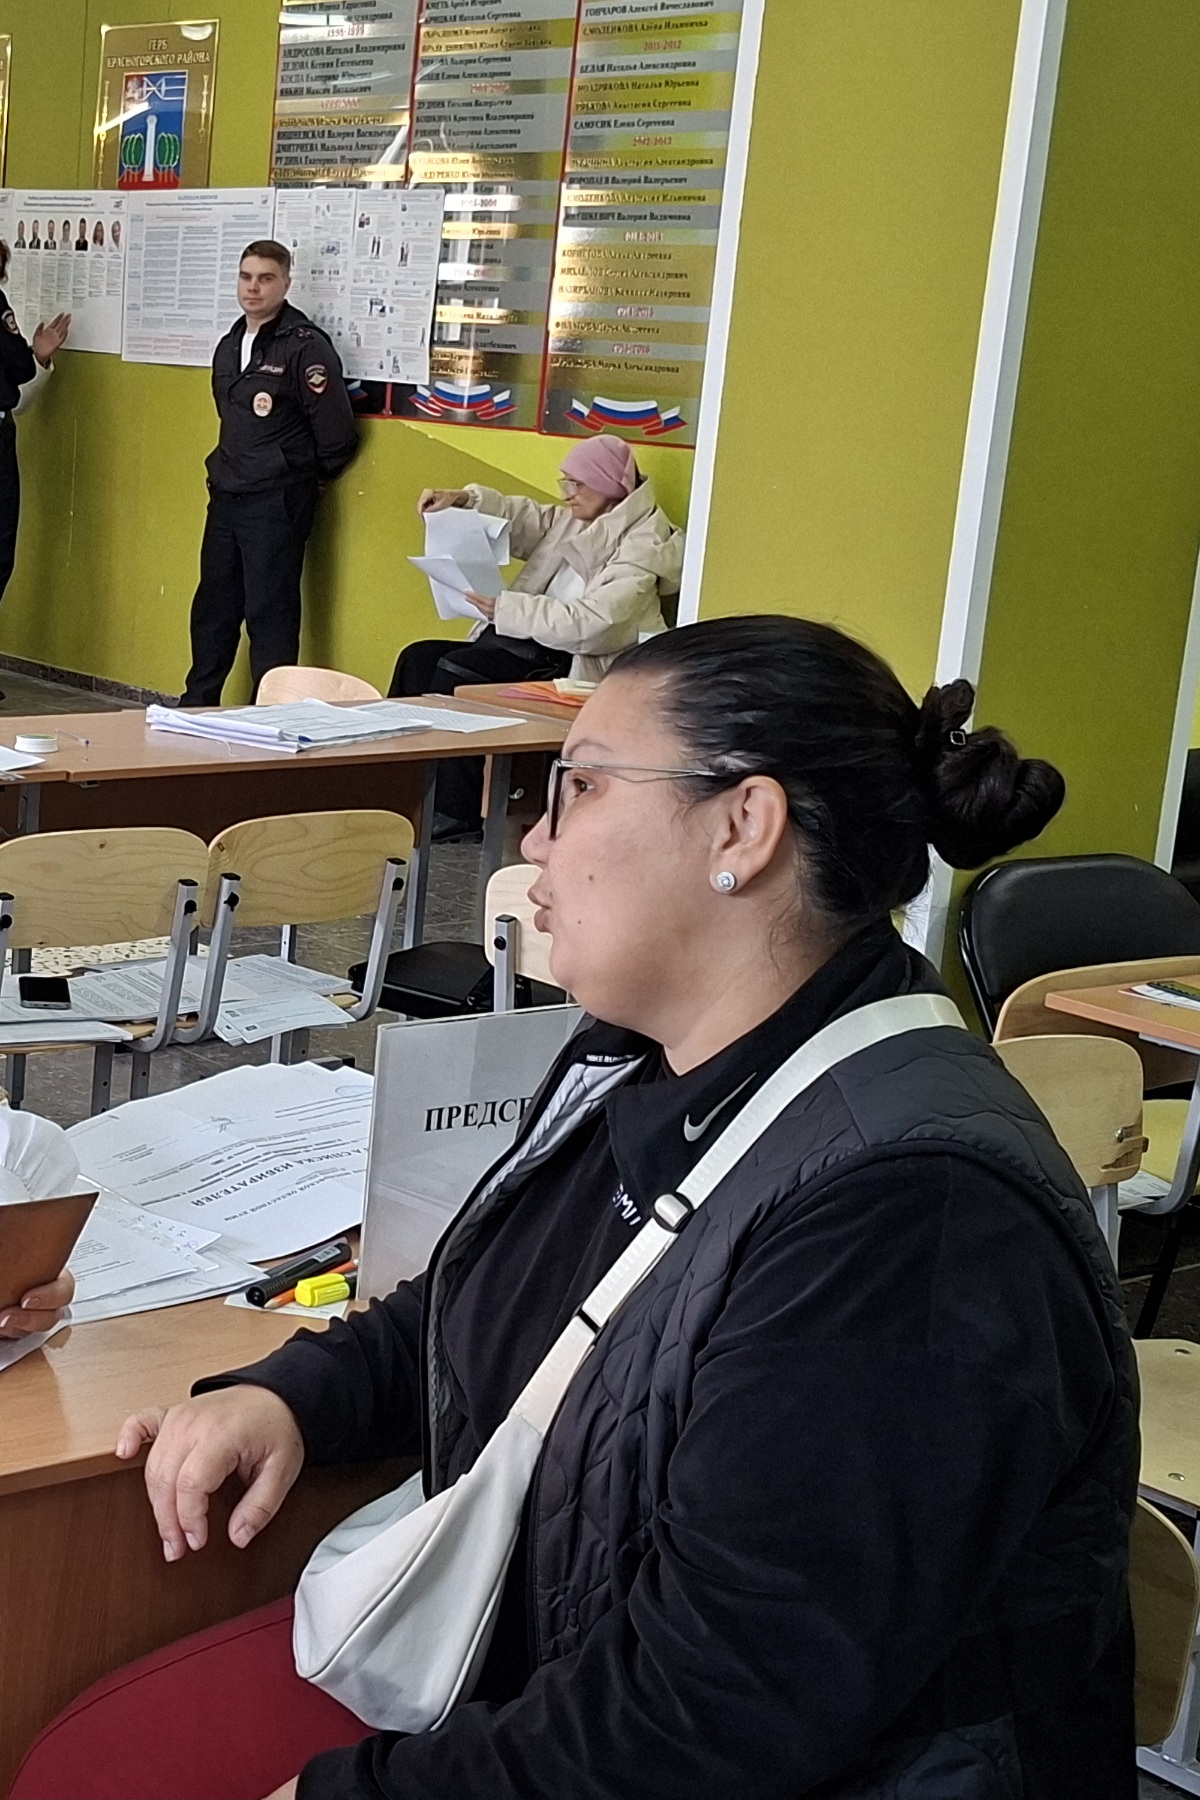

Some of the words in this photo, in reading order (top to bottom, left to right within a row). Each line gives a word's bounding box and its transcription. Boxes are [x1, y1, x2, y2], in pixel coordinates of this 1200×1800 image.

[585, 5, 627, 17] ГОНЧАРОВ
[628, 3, 658, 13] Алексей
[177, 50, 210, 63] РАЙОНА
[607, 63, 637, 72] Наталья
[640, 61, 696, 70] Александровна
[631, 81, 662, 90] Наталья
[664, 80, 699, 91] Юрьевна
[614, 119, 635, 128] Елена
[637, 118, 675, 128] Сергеевна
[191, 1162, 294, 1208] ИЗБИРАТЕЛЕЙ
